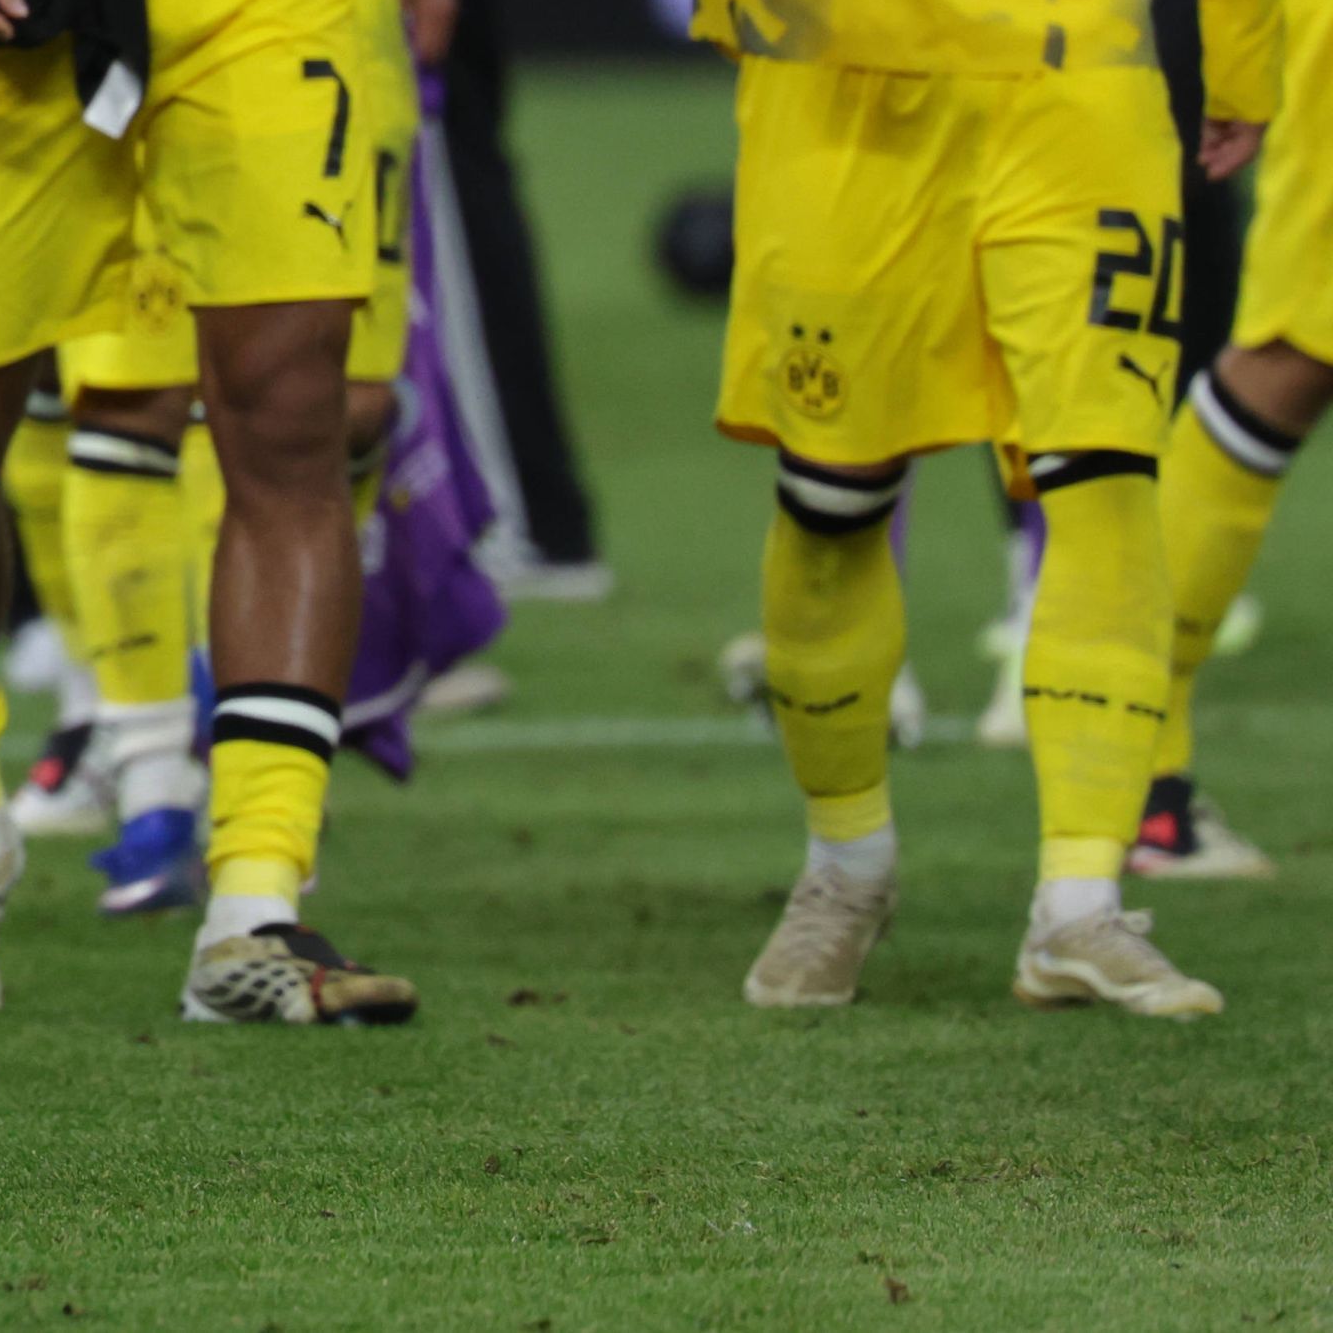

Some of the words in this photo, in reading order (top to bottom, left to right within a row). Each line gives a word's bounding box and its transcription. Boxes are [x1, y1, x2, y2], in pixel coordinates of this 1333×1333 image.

[303, 60, 350, 177] 7
[1088, 207, 1184, 341] 20
[788, 352, 840, 399] BVB
